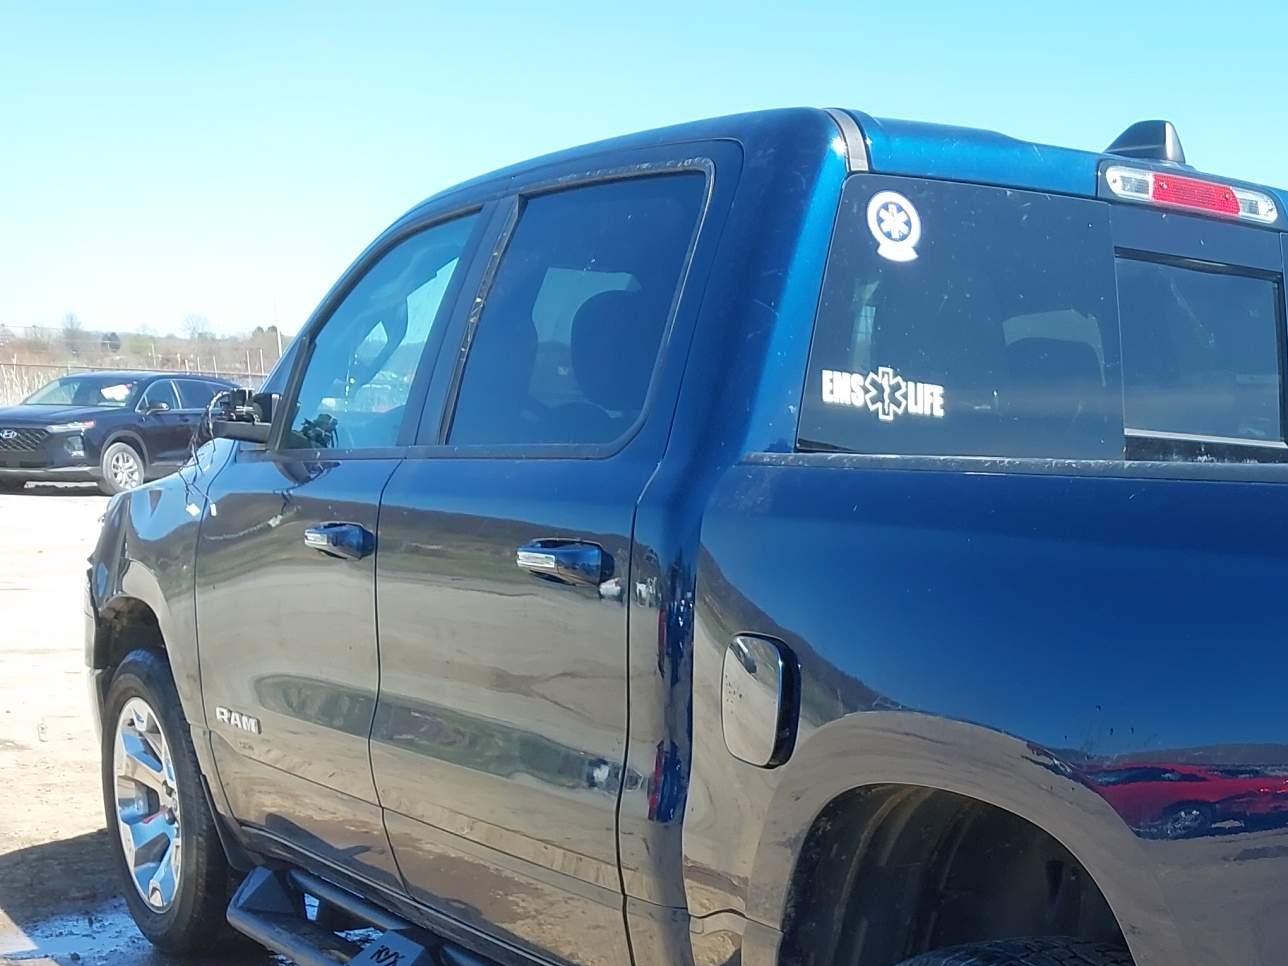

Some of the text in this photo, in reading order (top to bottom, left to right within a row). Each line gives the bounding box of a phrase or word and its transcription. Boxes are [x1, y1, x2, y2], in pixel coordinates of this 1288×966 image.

[822, 369, 945, 417] EMS LIFE
[215, 705, 262, 735] RAM
